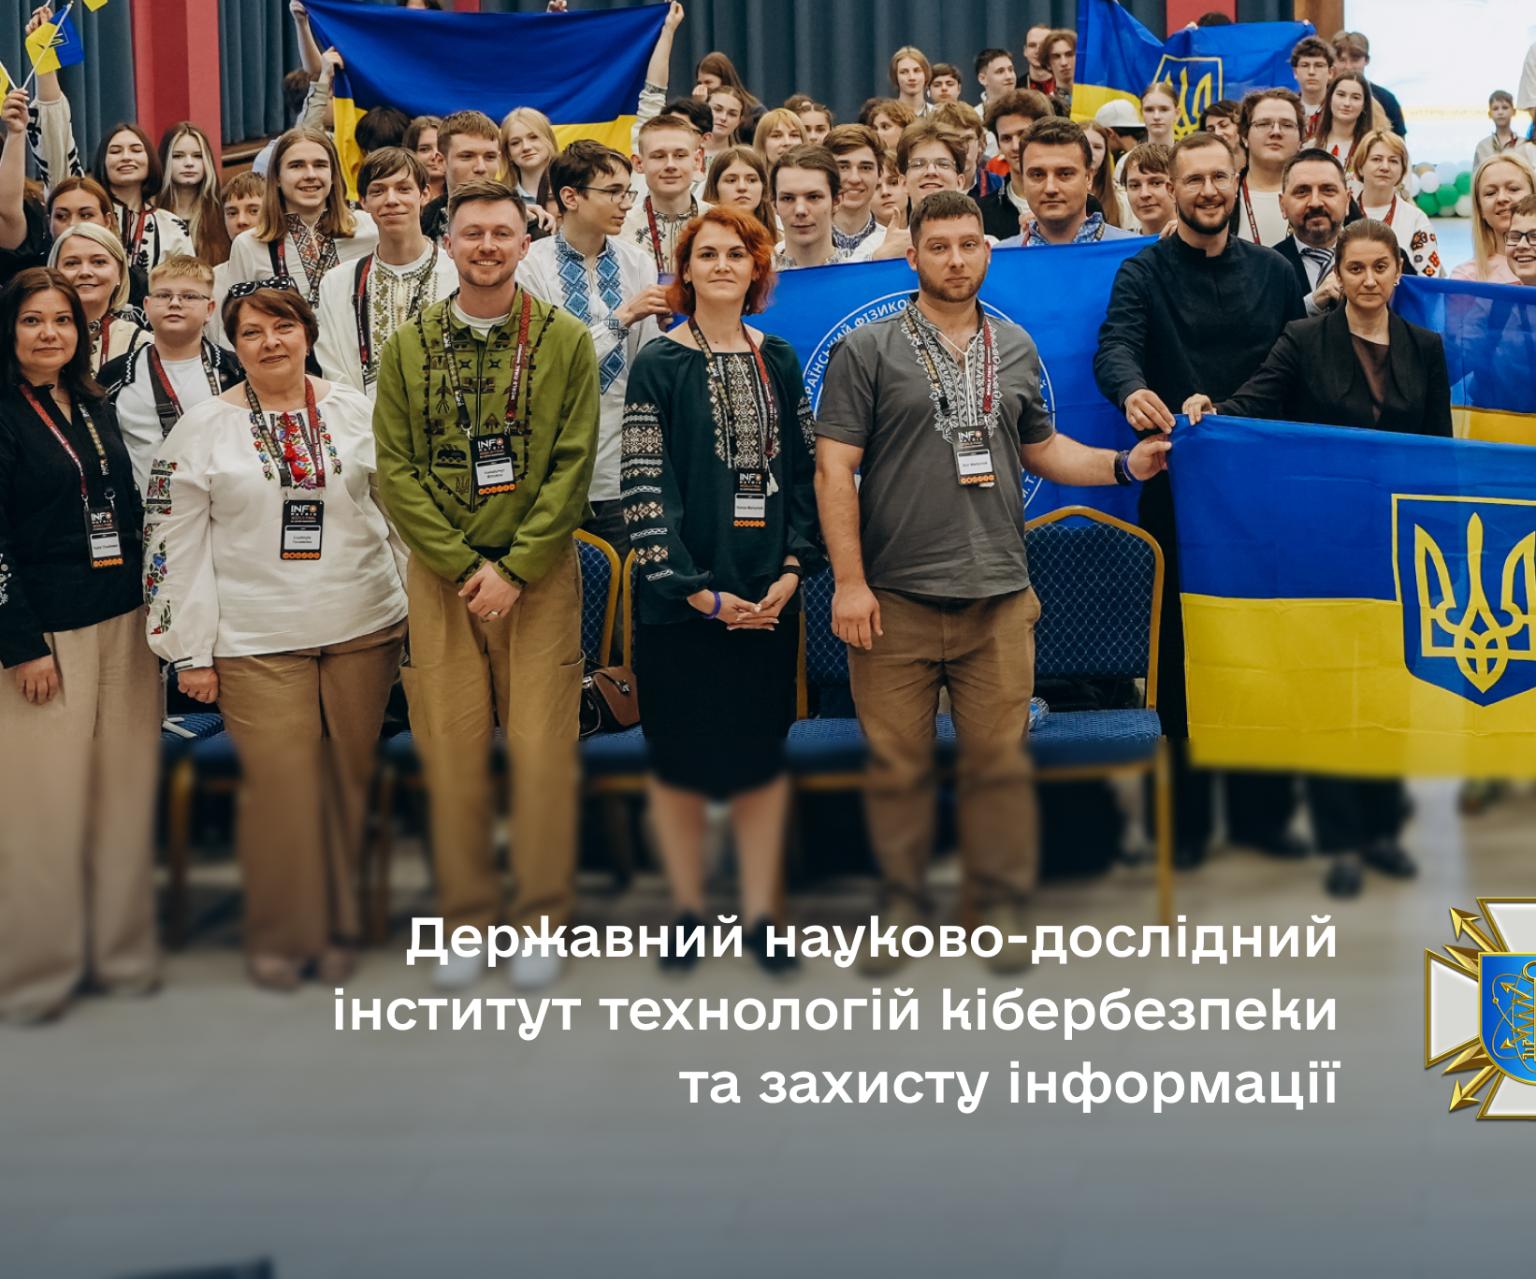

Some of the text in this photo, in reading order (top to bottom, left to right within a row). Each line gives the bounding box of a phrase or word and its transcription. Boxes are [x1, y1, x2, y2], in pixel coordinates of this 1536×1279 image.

[958, 430, 983, 442] INFO
[478, 437, 504, 450] INFO
[740, 473, 762, 481] INFO
[290, 505, 318, 513] INFO
[90, 512, 113, 521] INFO
